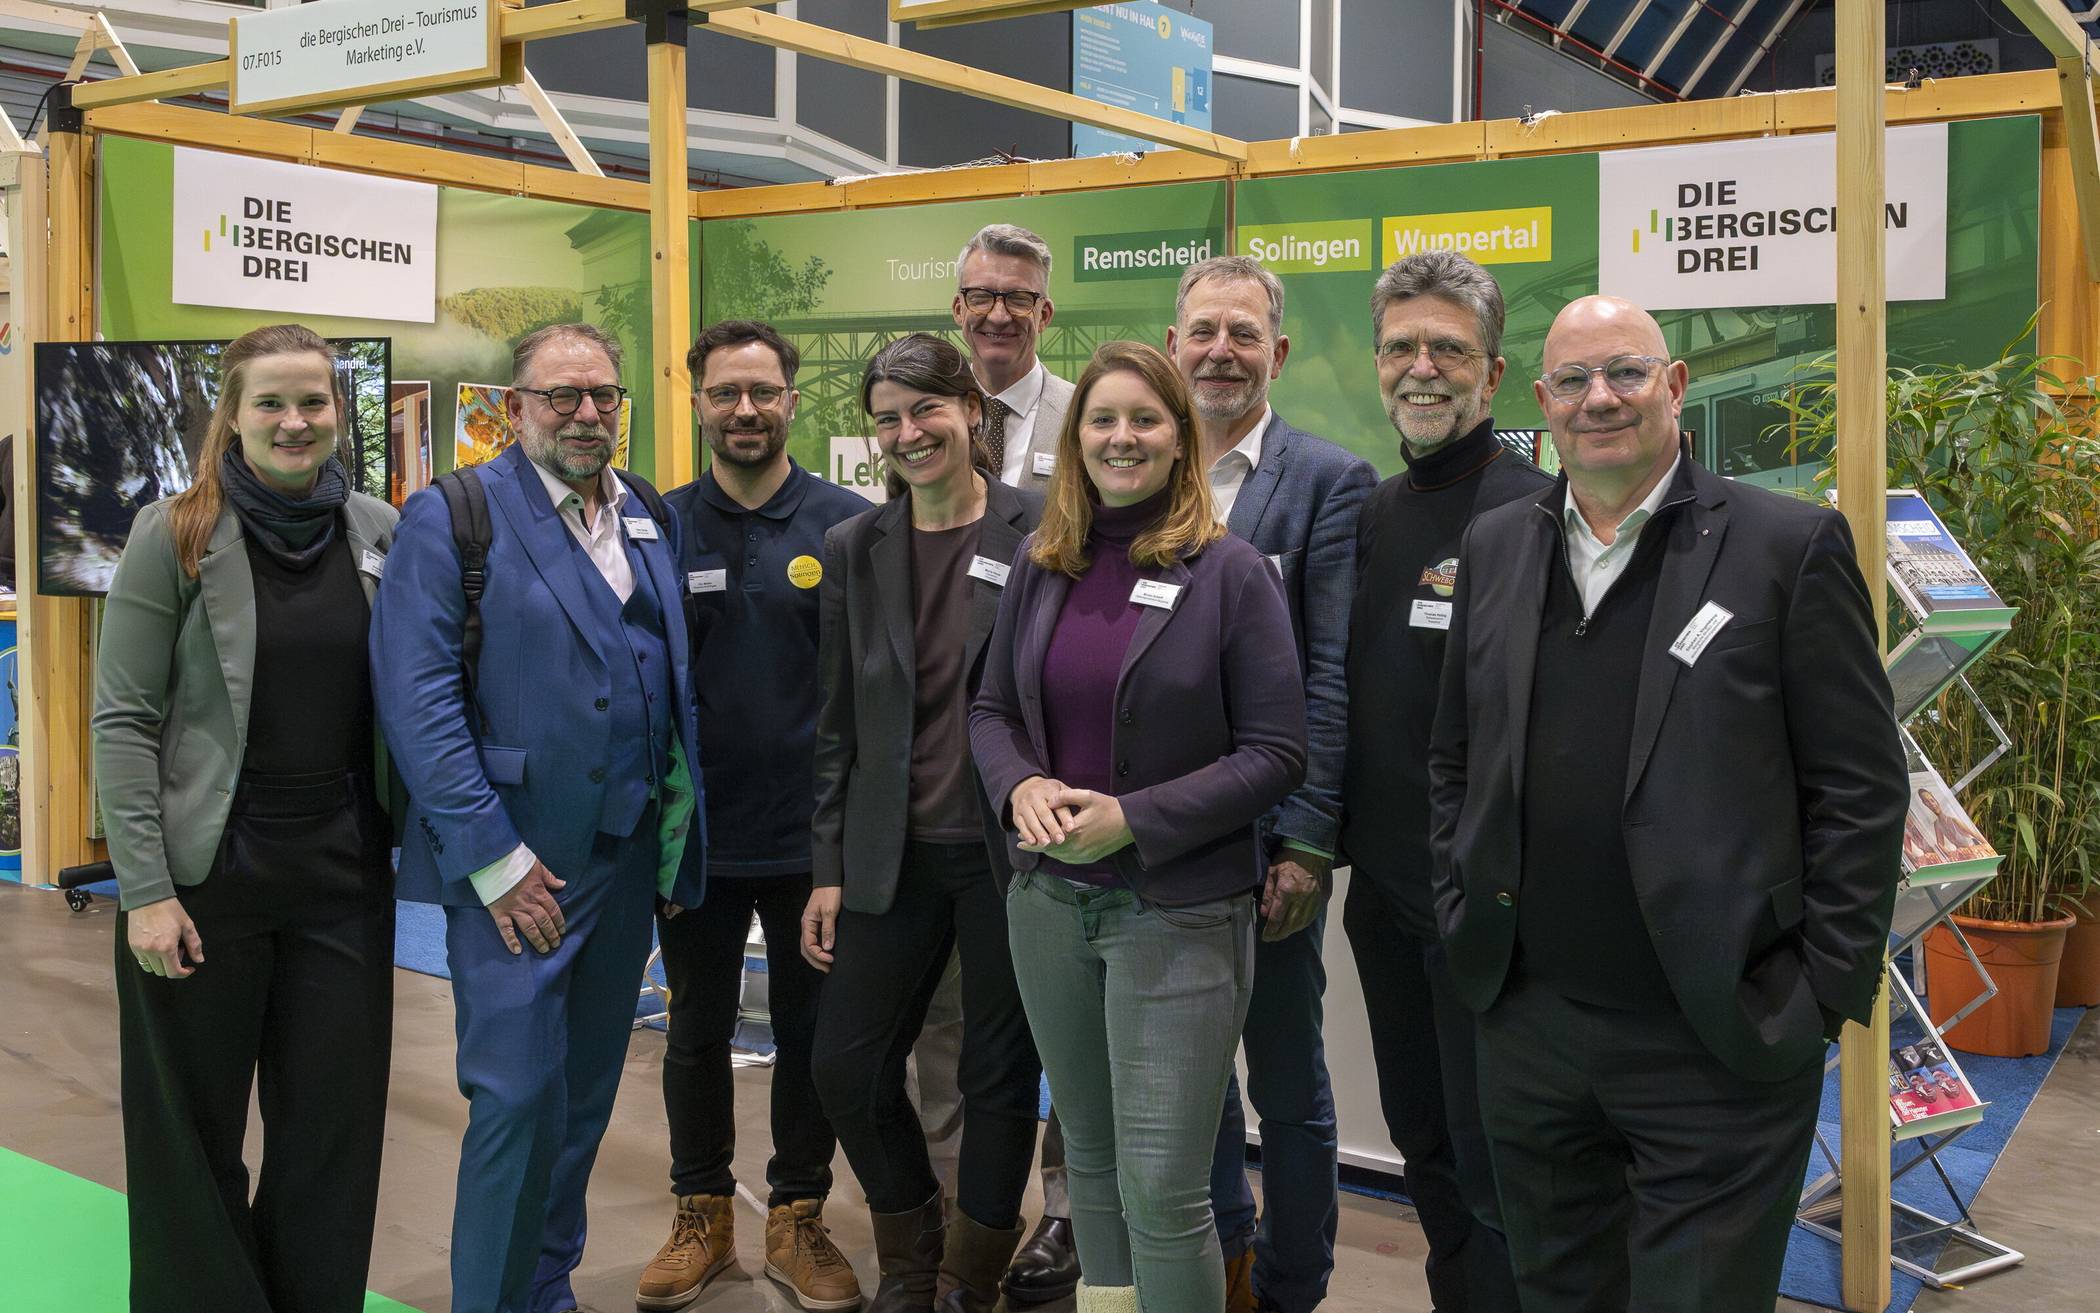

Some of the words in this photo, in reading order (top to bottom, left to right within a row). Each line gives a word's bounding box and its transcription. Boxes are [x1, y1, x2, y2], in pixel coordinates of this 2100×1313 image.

[300, 31, 317, 48] die
[319, 22, 378, 47] Bergischen
[382, 15, 405, 35] Drei
[416, 5, 477, 28] Tourismus
[1140, 15, 1156, 30] HAL
[242, 49, 282, 71] 07.F015
[346, 43, 403, 66] Marketing
[405, 38, 426, 57] e.V.
[1678, 180, 1737, 209] DIE
[243, 196, 292, 224] DIE
[1665, 202, 1908, 242] BERGISCN
[233, 224, 412, 265] BERGISCHEN
[1249, 235, 1360, 266] Solingen
[1394, 219, 1538, 256] Wuppertal
[242, 255, 308, 283] DREI
[1083, 238, 1211, 271] Remscheid
[1677, 245, 1759, 274] DREI
[335, 357, 368, 370] endrei
[837, 453, 887, 487] Lek
[1421, 570, 1456, 585] SCHWEBO
